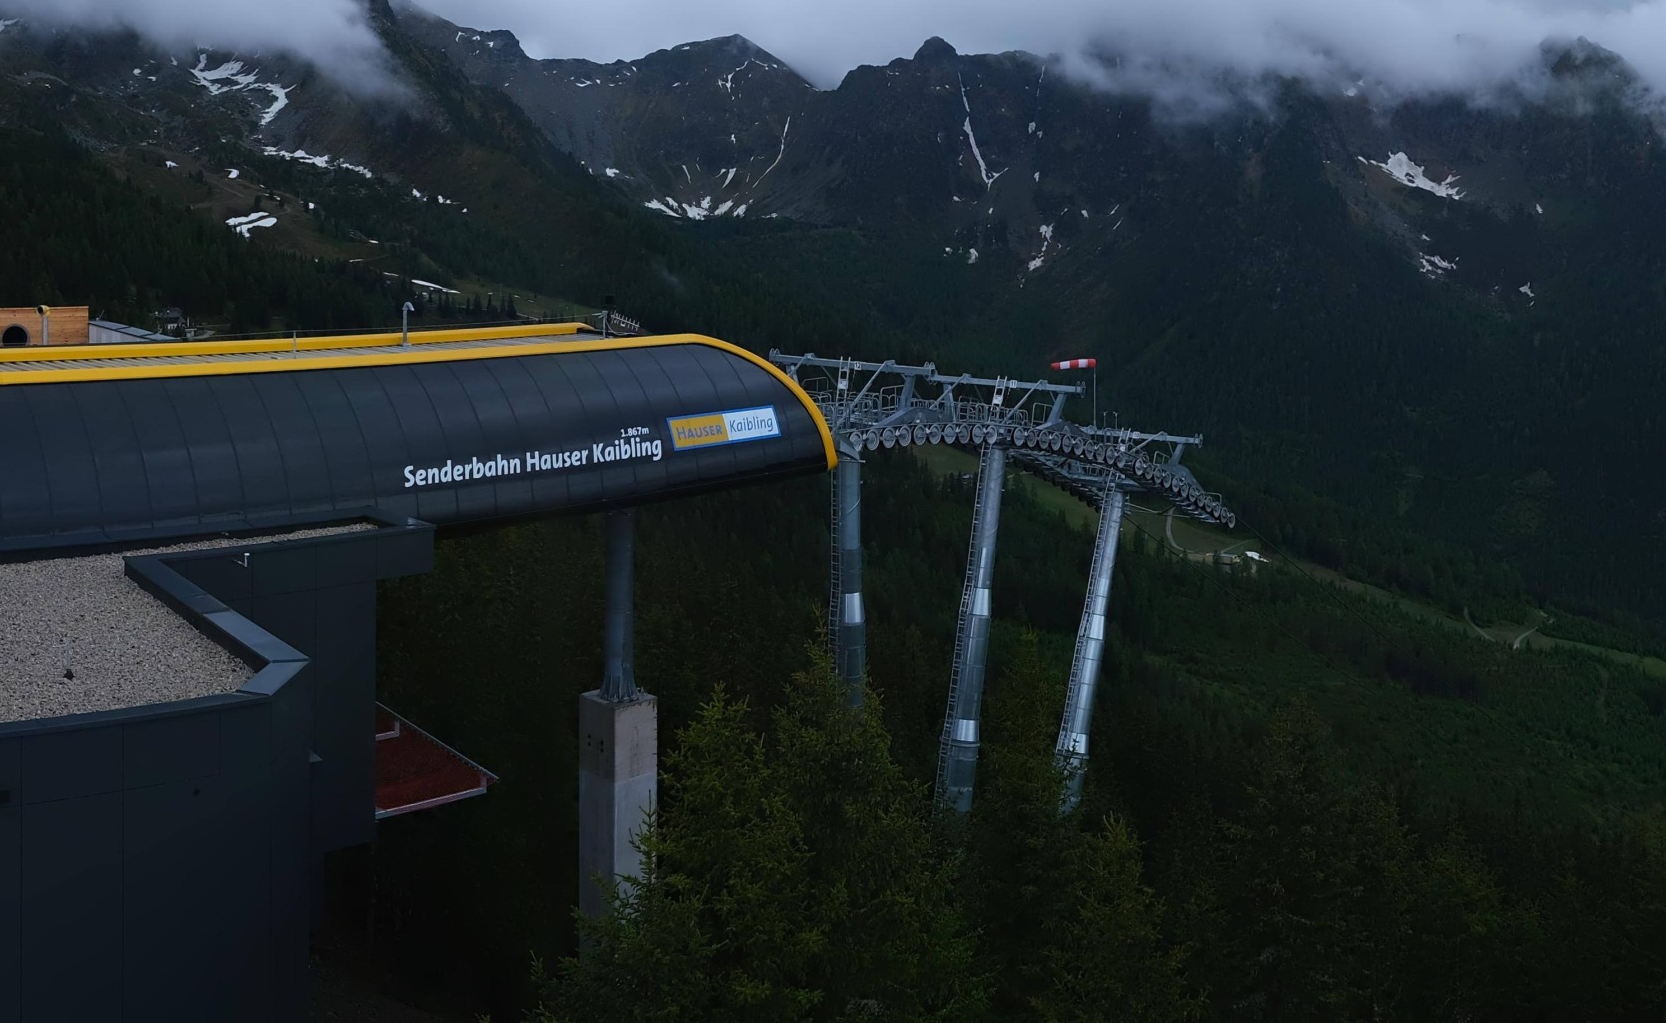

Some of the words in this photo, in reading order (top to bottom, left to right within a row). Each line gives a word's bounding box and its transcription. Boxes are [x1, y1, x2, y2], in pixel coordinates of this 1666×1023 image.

[620, 427, 649, 437] 1.867m
[676, 424, 723, 441] HAUSER
[729, 415, 774, 434] Kaibling
[404, 454, 521, 488] Senderbahn
[526, 449, 588, 472] Hauser
[592, 437, 662, 463] Kaibling
